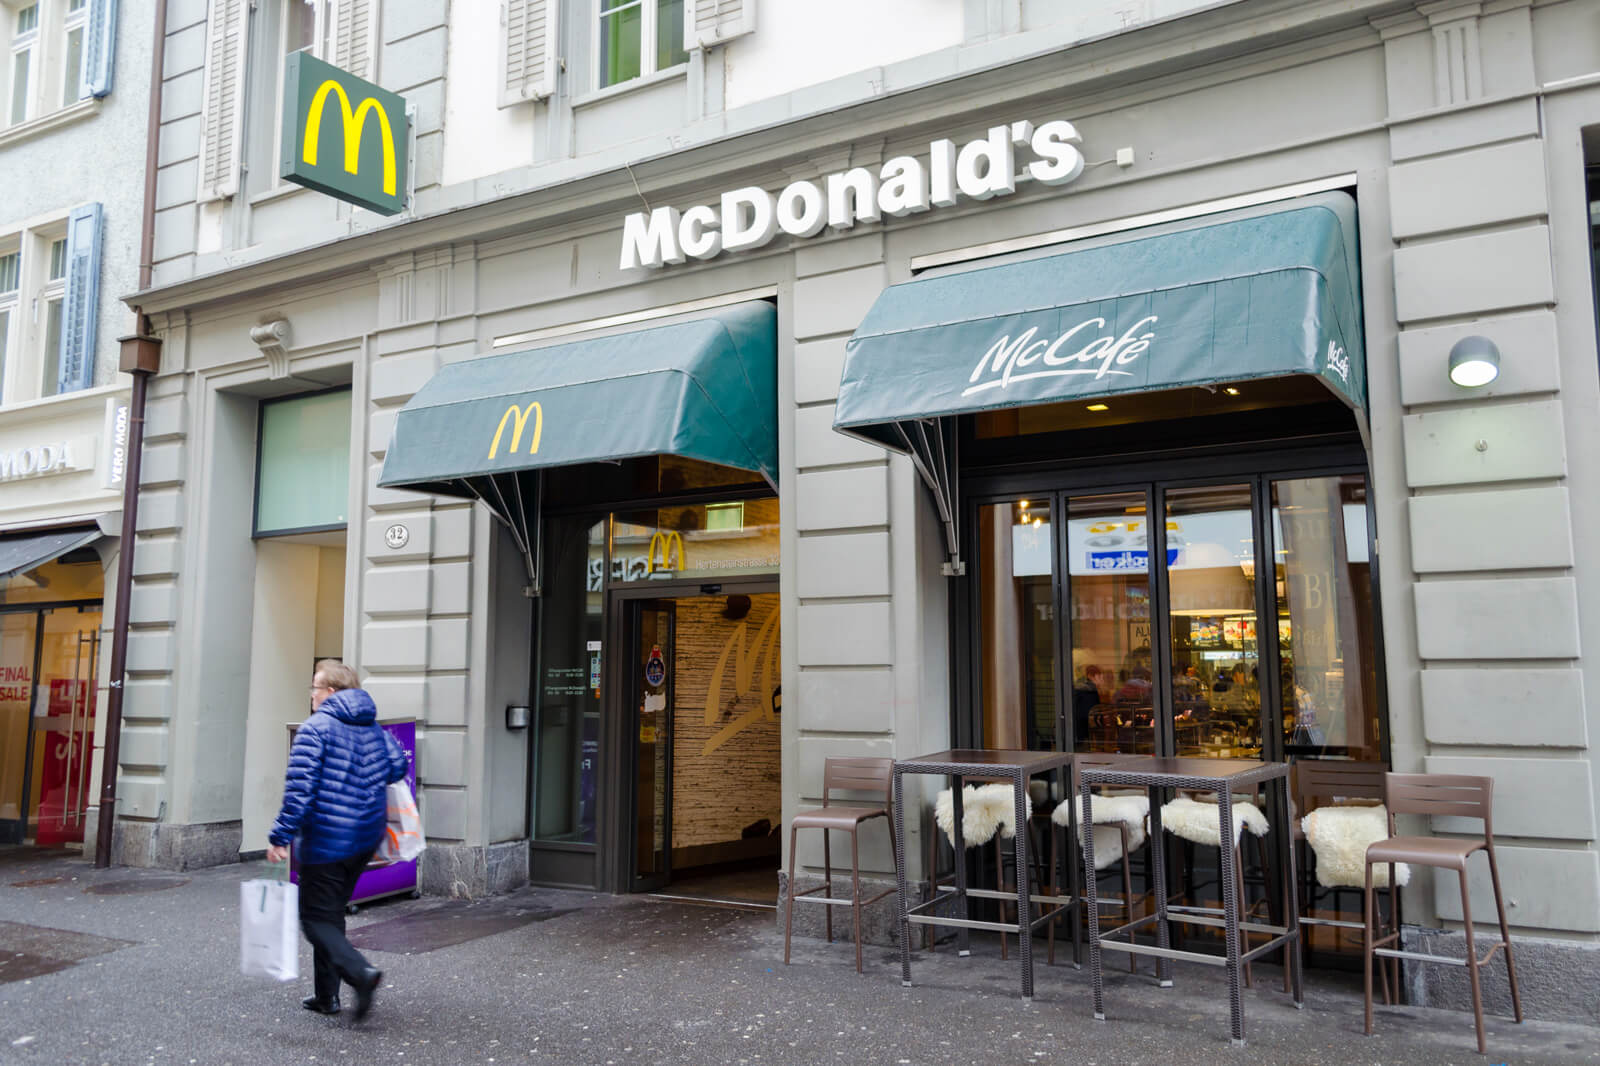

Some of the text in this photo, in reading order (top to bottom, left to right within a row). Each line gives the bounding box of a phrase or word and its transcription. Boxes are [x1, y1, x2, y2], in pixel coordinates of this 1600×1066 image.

[619, 119, 1086, 271] McDonald's
[962, 316, 1159, 397] McCafé
[0, 441, 74, 481] MODA
[111, 405, 128, 483] VERO MODA
[390, 527, 403, 540] 32
[0, 686, 28, 701] SALE
